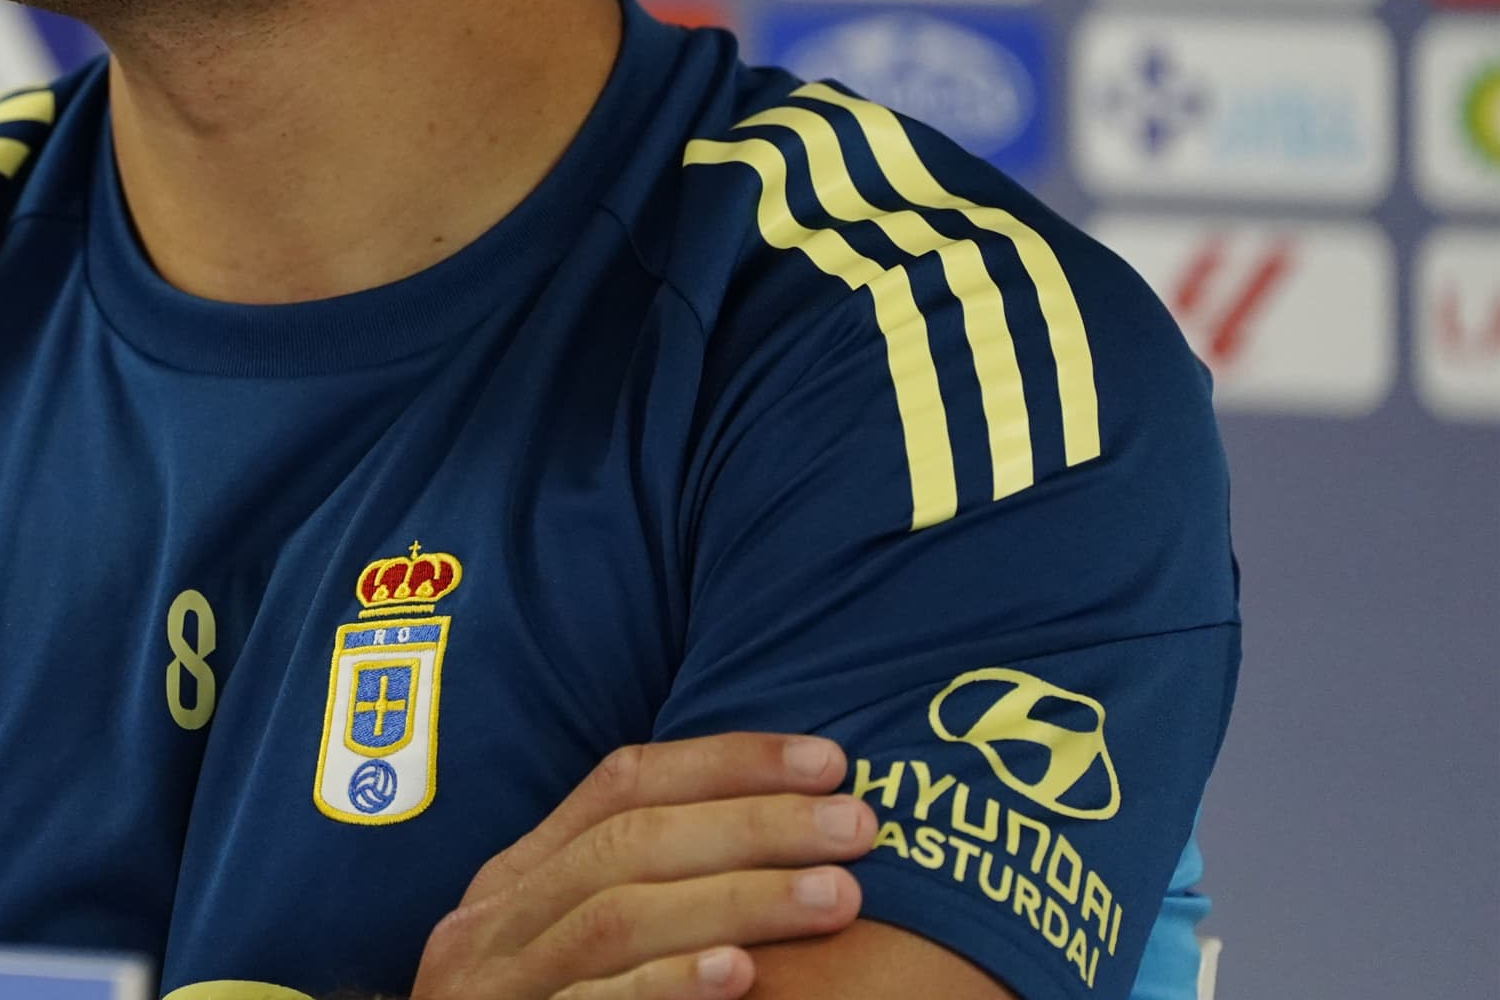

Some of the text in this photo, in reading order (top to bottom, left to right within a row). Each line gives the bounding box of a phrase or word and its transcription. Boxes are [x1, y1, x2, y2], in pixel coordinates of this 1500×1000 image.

[166, 589, 216, 730] 8
[852, 758, 1123, 956] HYUNDAI
[871, 821, 1099, 989] ASTURDAI
